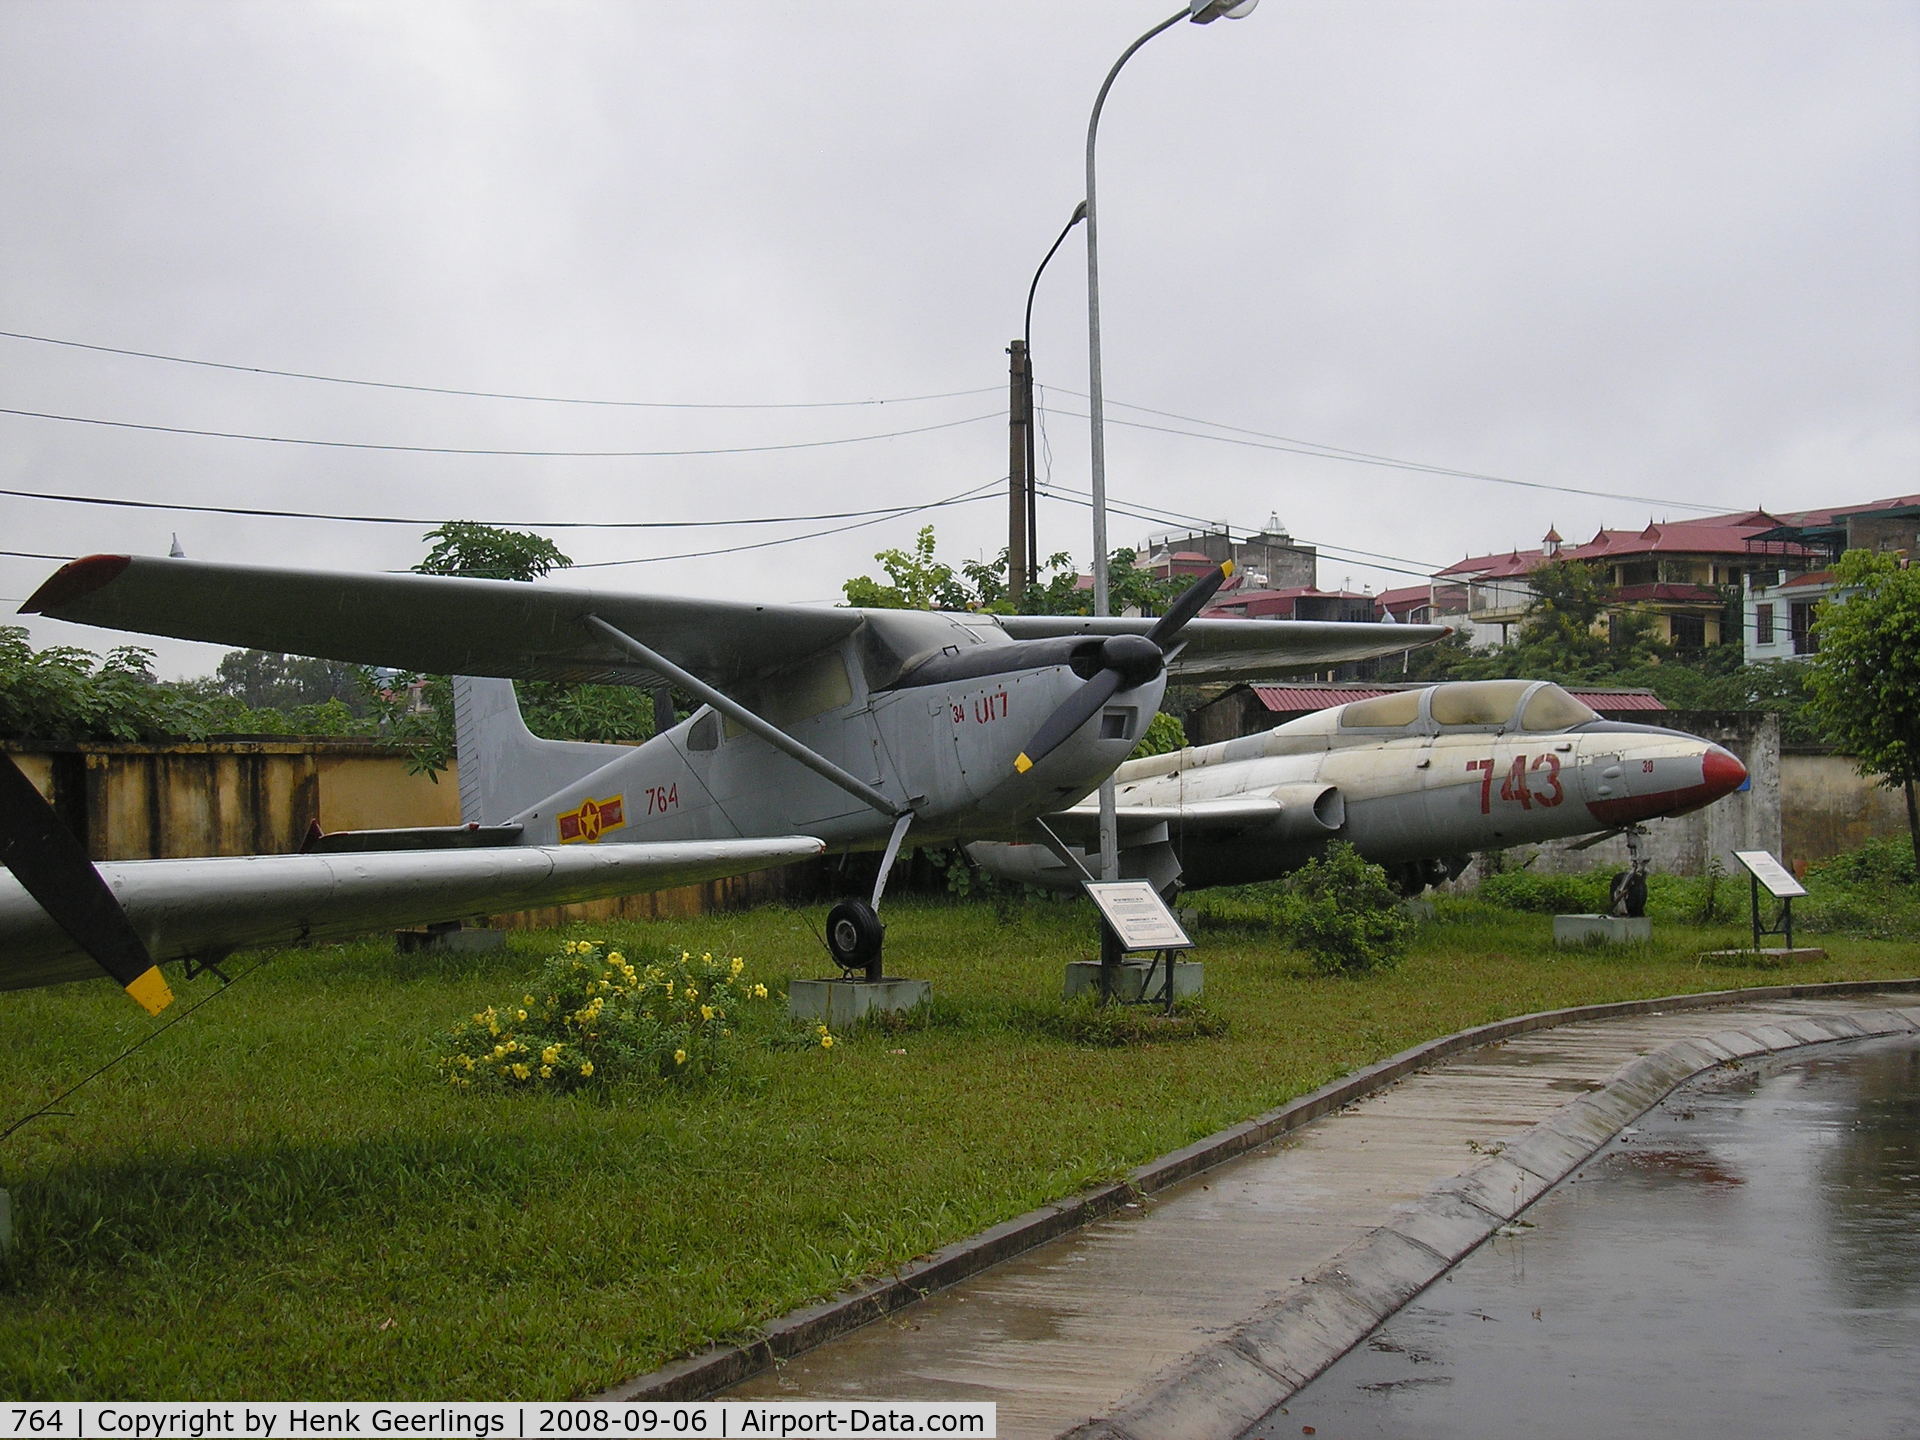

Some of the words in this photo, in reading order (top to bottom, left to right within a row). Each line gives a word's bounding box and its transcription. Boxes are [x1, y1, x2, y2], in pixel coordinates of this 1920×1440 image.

[952, 704, 965, 724] 34
[645, 782, 679, 815] 764
[1465, 753, 1564, 815] 743
